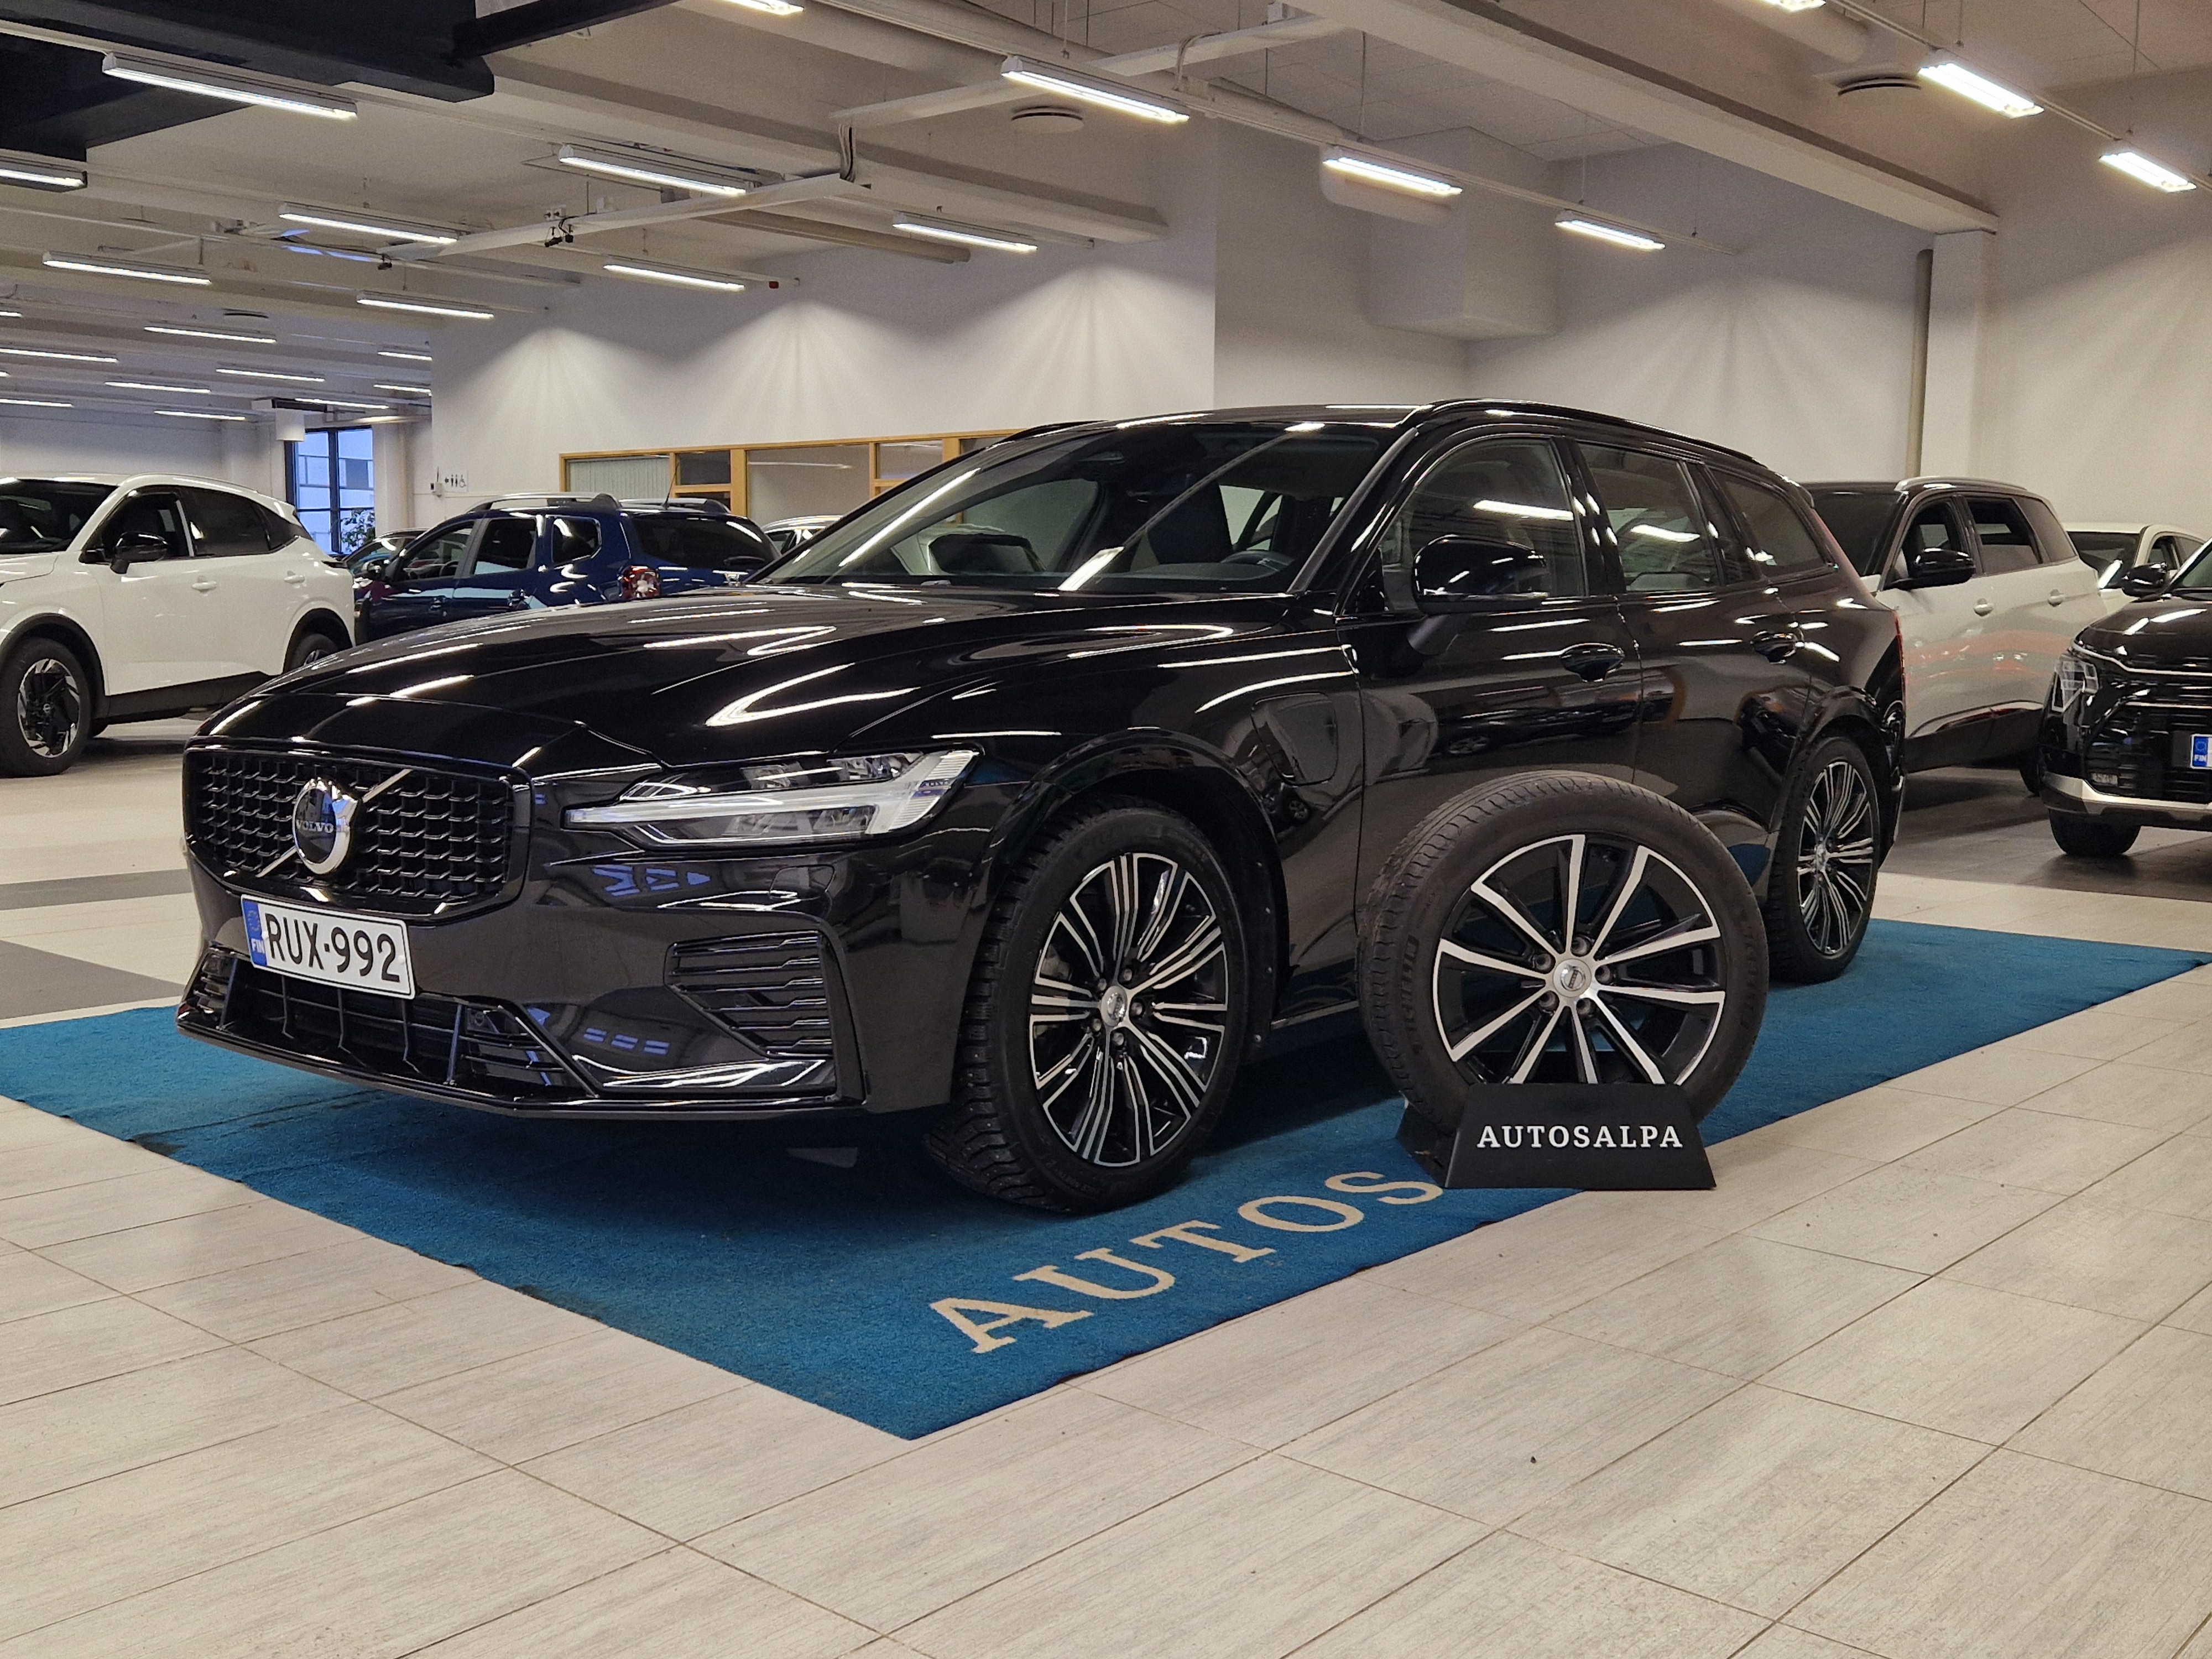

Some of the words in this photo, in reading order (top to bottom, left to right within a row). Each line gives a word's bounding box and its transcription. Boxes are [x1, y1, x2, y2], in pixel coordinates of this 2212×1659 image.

[296, 820, 334, 833] VOLVO
[252, 938, 264, 954] FIN
[265, 914, 400, 982] RUX-992
[1477, 1125, 1683, 1148] AUTOSALPA
[930, 1171, 1443, 1353] AUTOS
